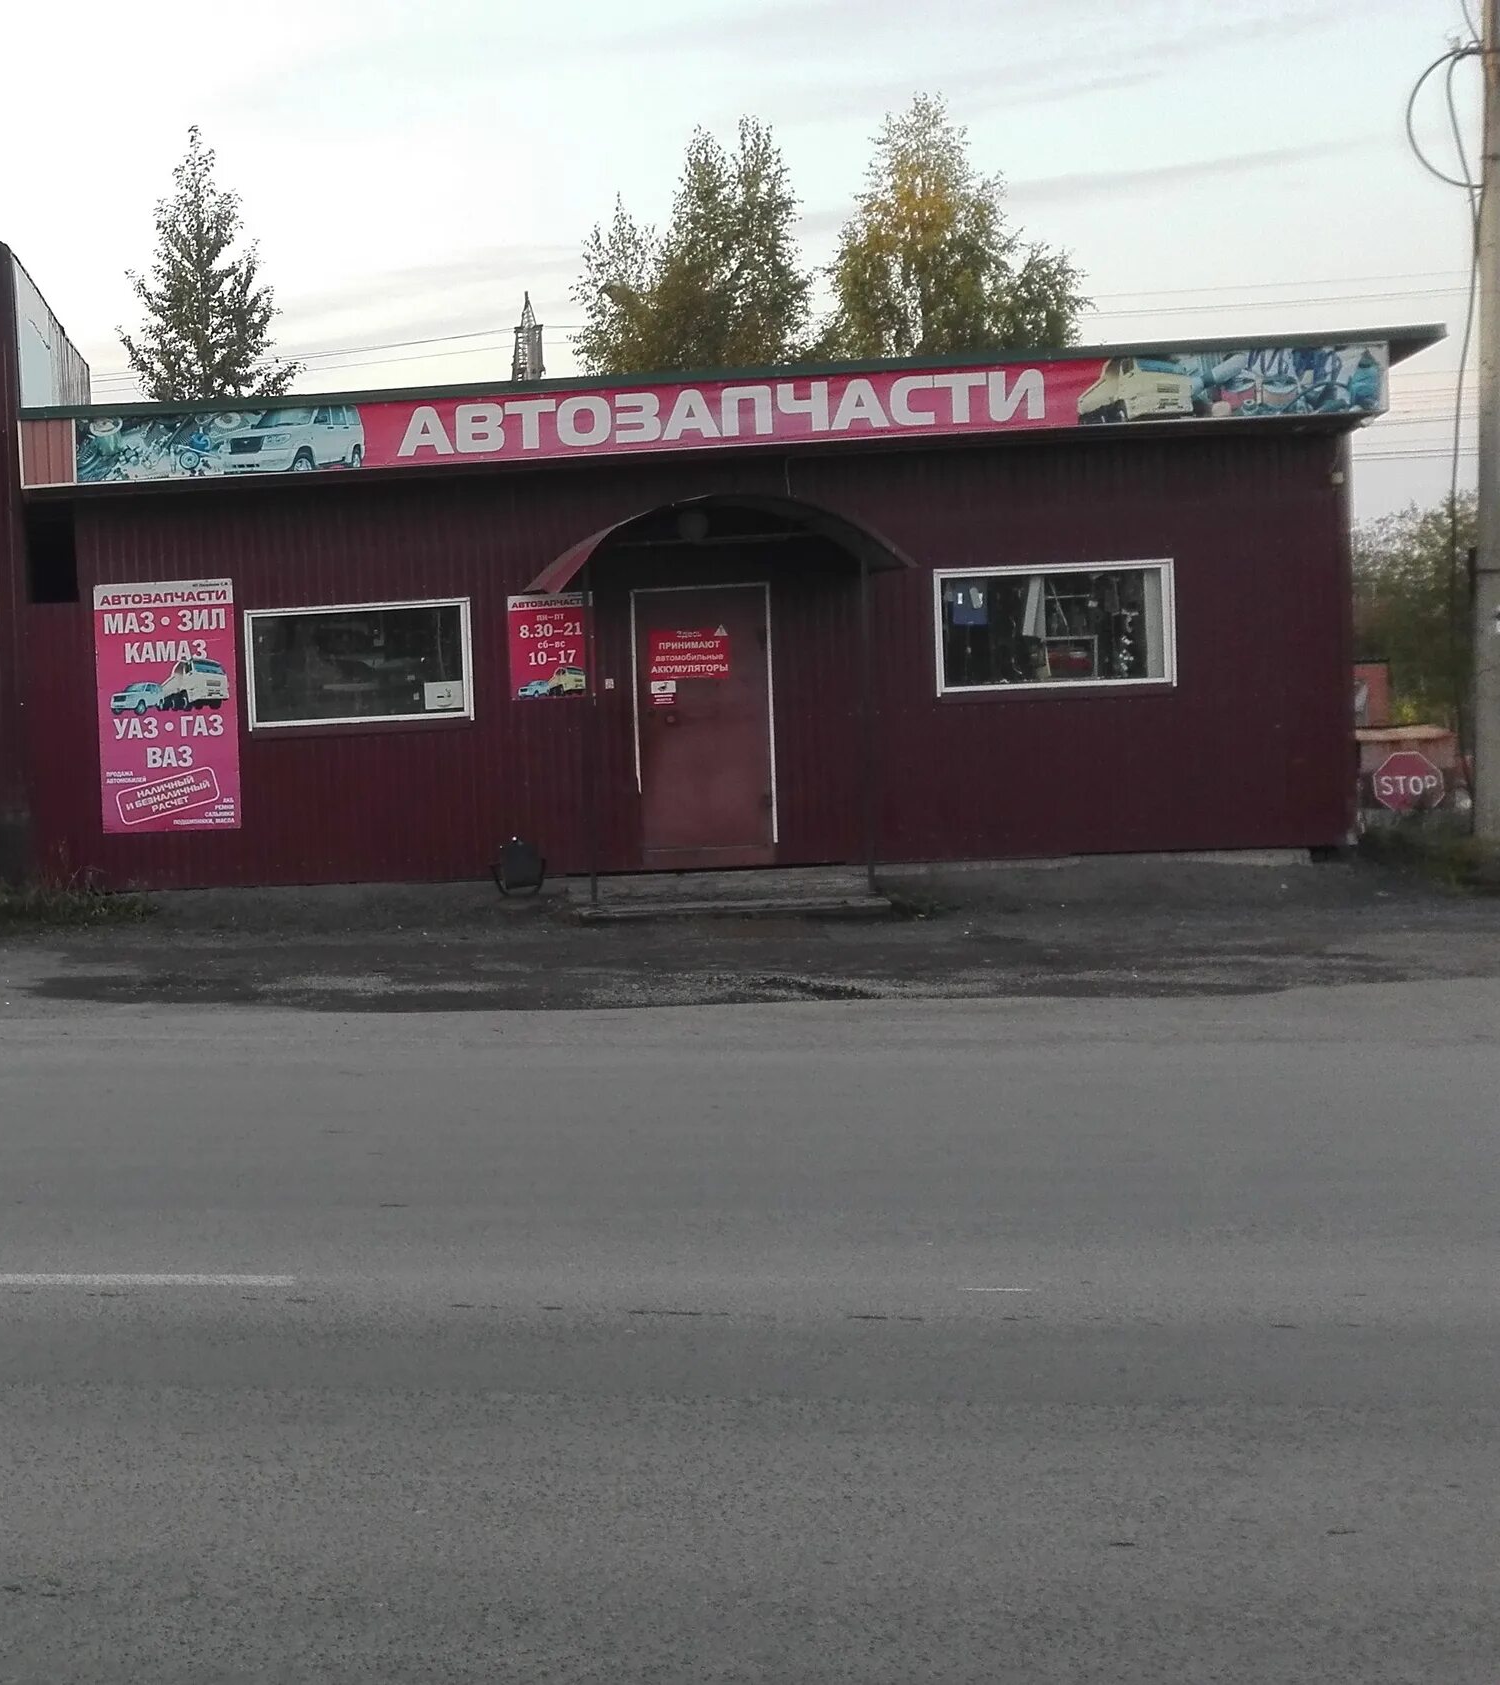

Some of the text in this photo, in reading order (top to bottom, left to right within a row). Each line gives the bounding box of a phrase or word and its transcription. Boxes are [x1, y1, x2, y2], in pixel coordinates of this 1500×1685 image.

[396, 368, 1046, 457] АВТОЗАПЧАСТИ
[100, 590, 227, 606] АВТОЗАПЧАСТИ
[511, 599, 584, 609] АВТОЗАПЧАСТ
[103, 608, 226, 635] МАЗ ЗИЛ
[124, 639, 208, 664] КАМАЗ
[659, 640, 721, 650] ПРИНИМАЮТ
[655, 653, 724, 661] автомобильные
[651, 664, 729, 673] АККУМУЛЯТОРЫ
[113, 714, 224, 740] УАЗ ГАЗ
[146, 745, 194, 768] ВАЗ
[125, 780, 211, 811] И БЕЗНАЛИЧНЫЙ
[136, 774, 195, 799] НАЛИЧНЫЙ
[1380, 775, 1438, 795] STOP
[151, 795, 190, 813] РАСЧЕТ
